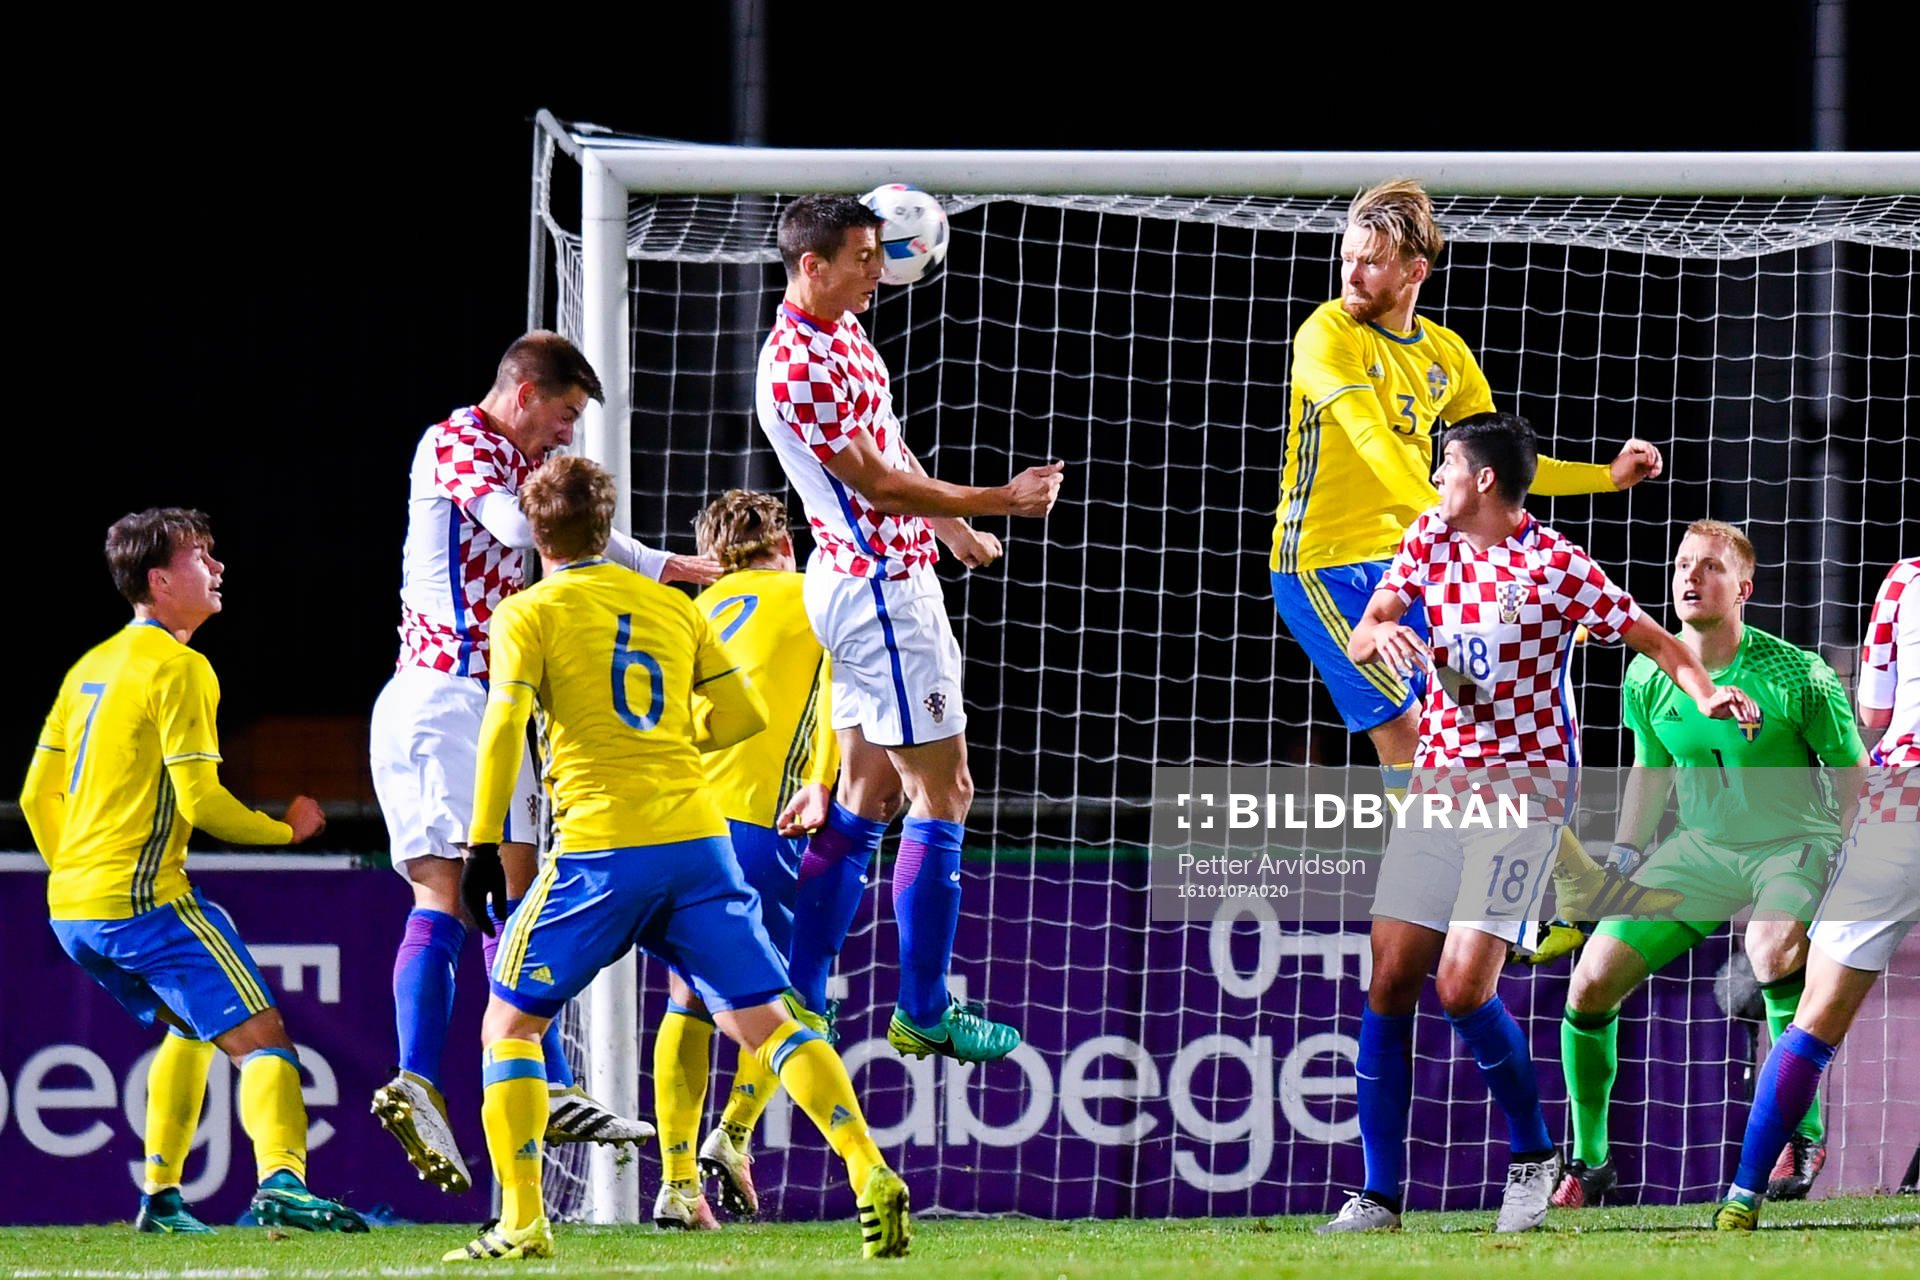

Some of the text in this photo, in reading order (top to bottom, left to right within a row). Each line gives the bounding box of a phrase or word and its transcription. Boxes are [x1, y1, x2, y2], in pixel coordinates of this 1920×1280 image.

[1393, 394, 1417, 436] 3
[611, 613, 665, 731] 6
[1453, 633, 1490, 680] 18
[69, 683, 106, 794] 7
[1711, 748, 1729, 789] 1
[1487, 855, 1529, 904] 18
